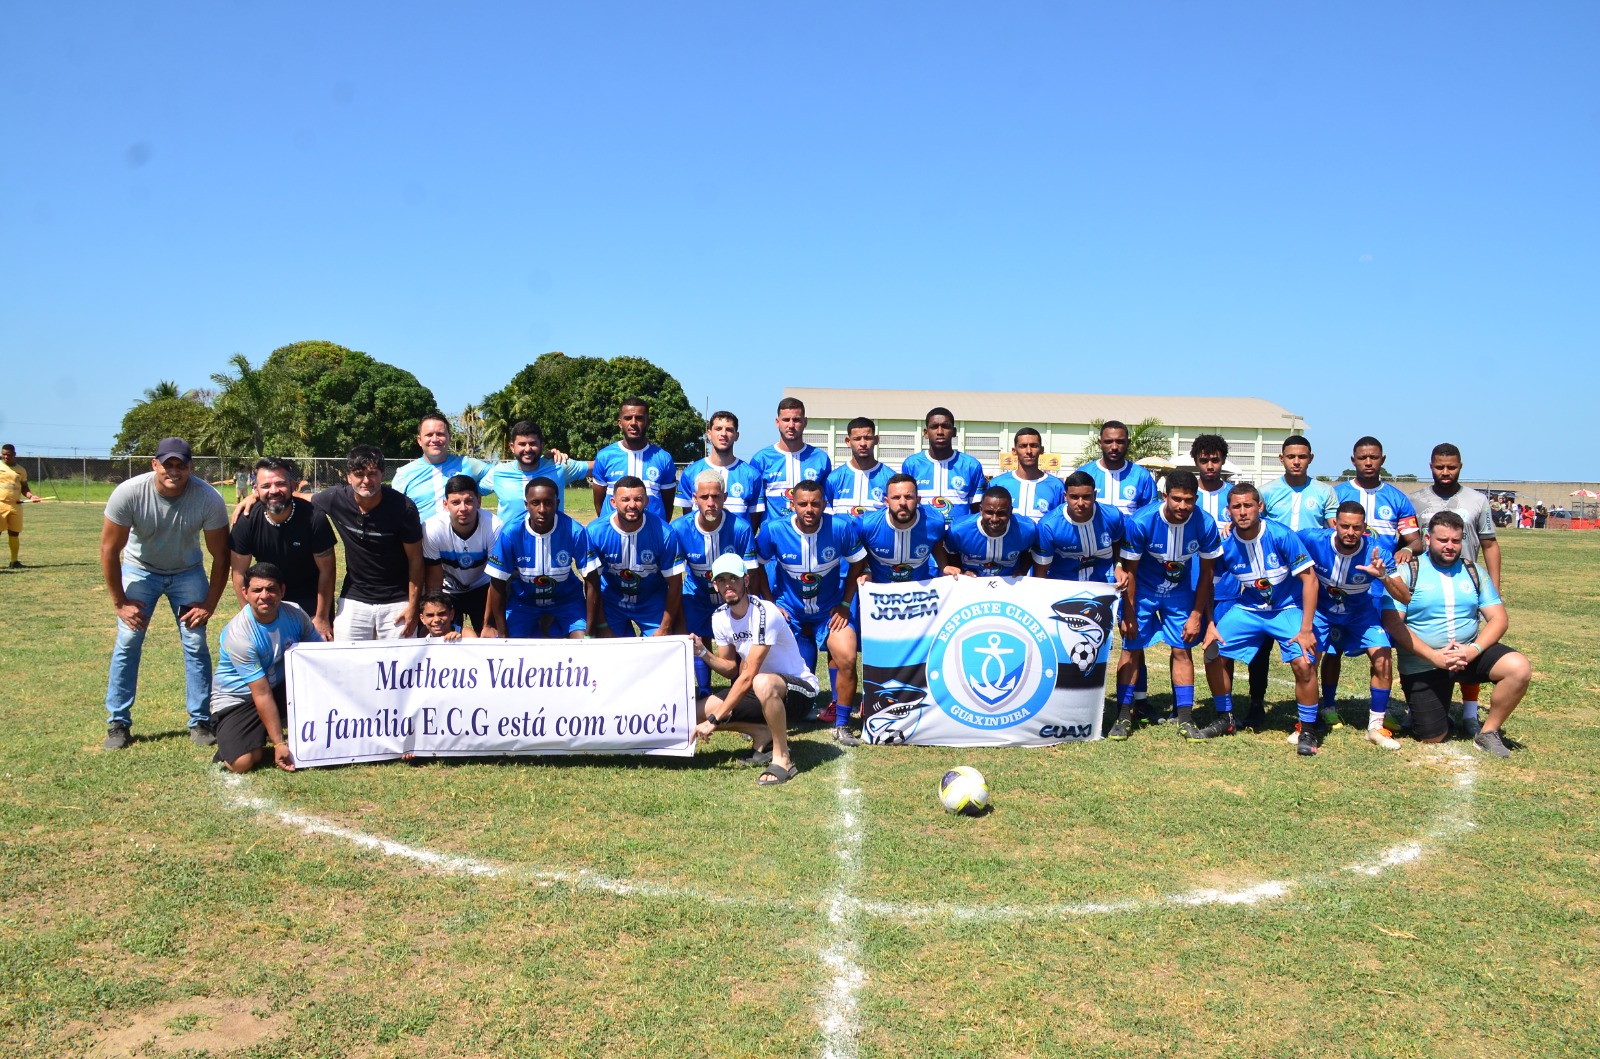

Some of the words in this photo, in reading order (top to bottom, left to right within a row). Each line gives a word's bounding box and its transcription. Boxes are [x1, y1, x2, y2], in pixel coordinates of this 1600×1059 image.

[869, 588, 940, 606] TORCIDA
[870, 603, 938, 621] JOVEM
[938, 603, 1001, 642] ESPORTE
[1005, 604, 1047, 642] CLUBE
[376, 658, 477, 690] Matheus
[487, 657, 597, 693] Valentin,
[301, 721, 317, 742] a
[325, 708, 415, 749] família
[422, 707, 489, 737] E.C.G
[498, 706, 546, 738] está
[555, 712, 606, 738] com
[613, 703, 678, 735] você!
[951, 705, 1030, 726] GUAXINDIBA
[1039, 724, 1092, 738] GUAXI
